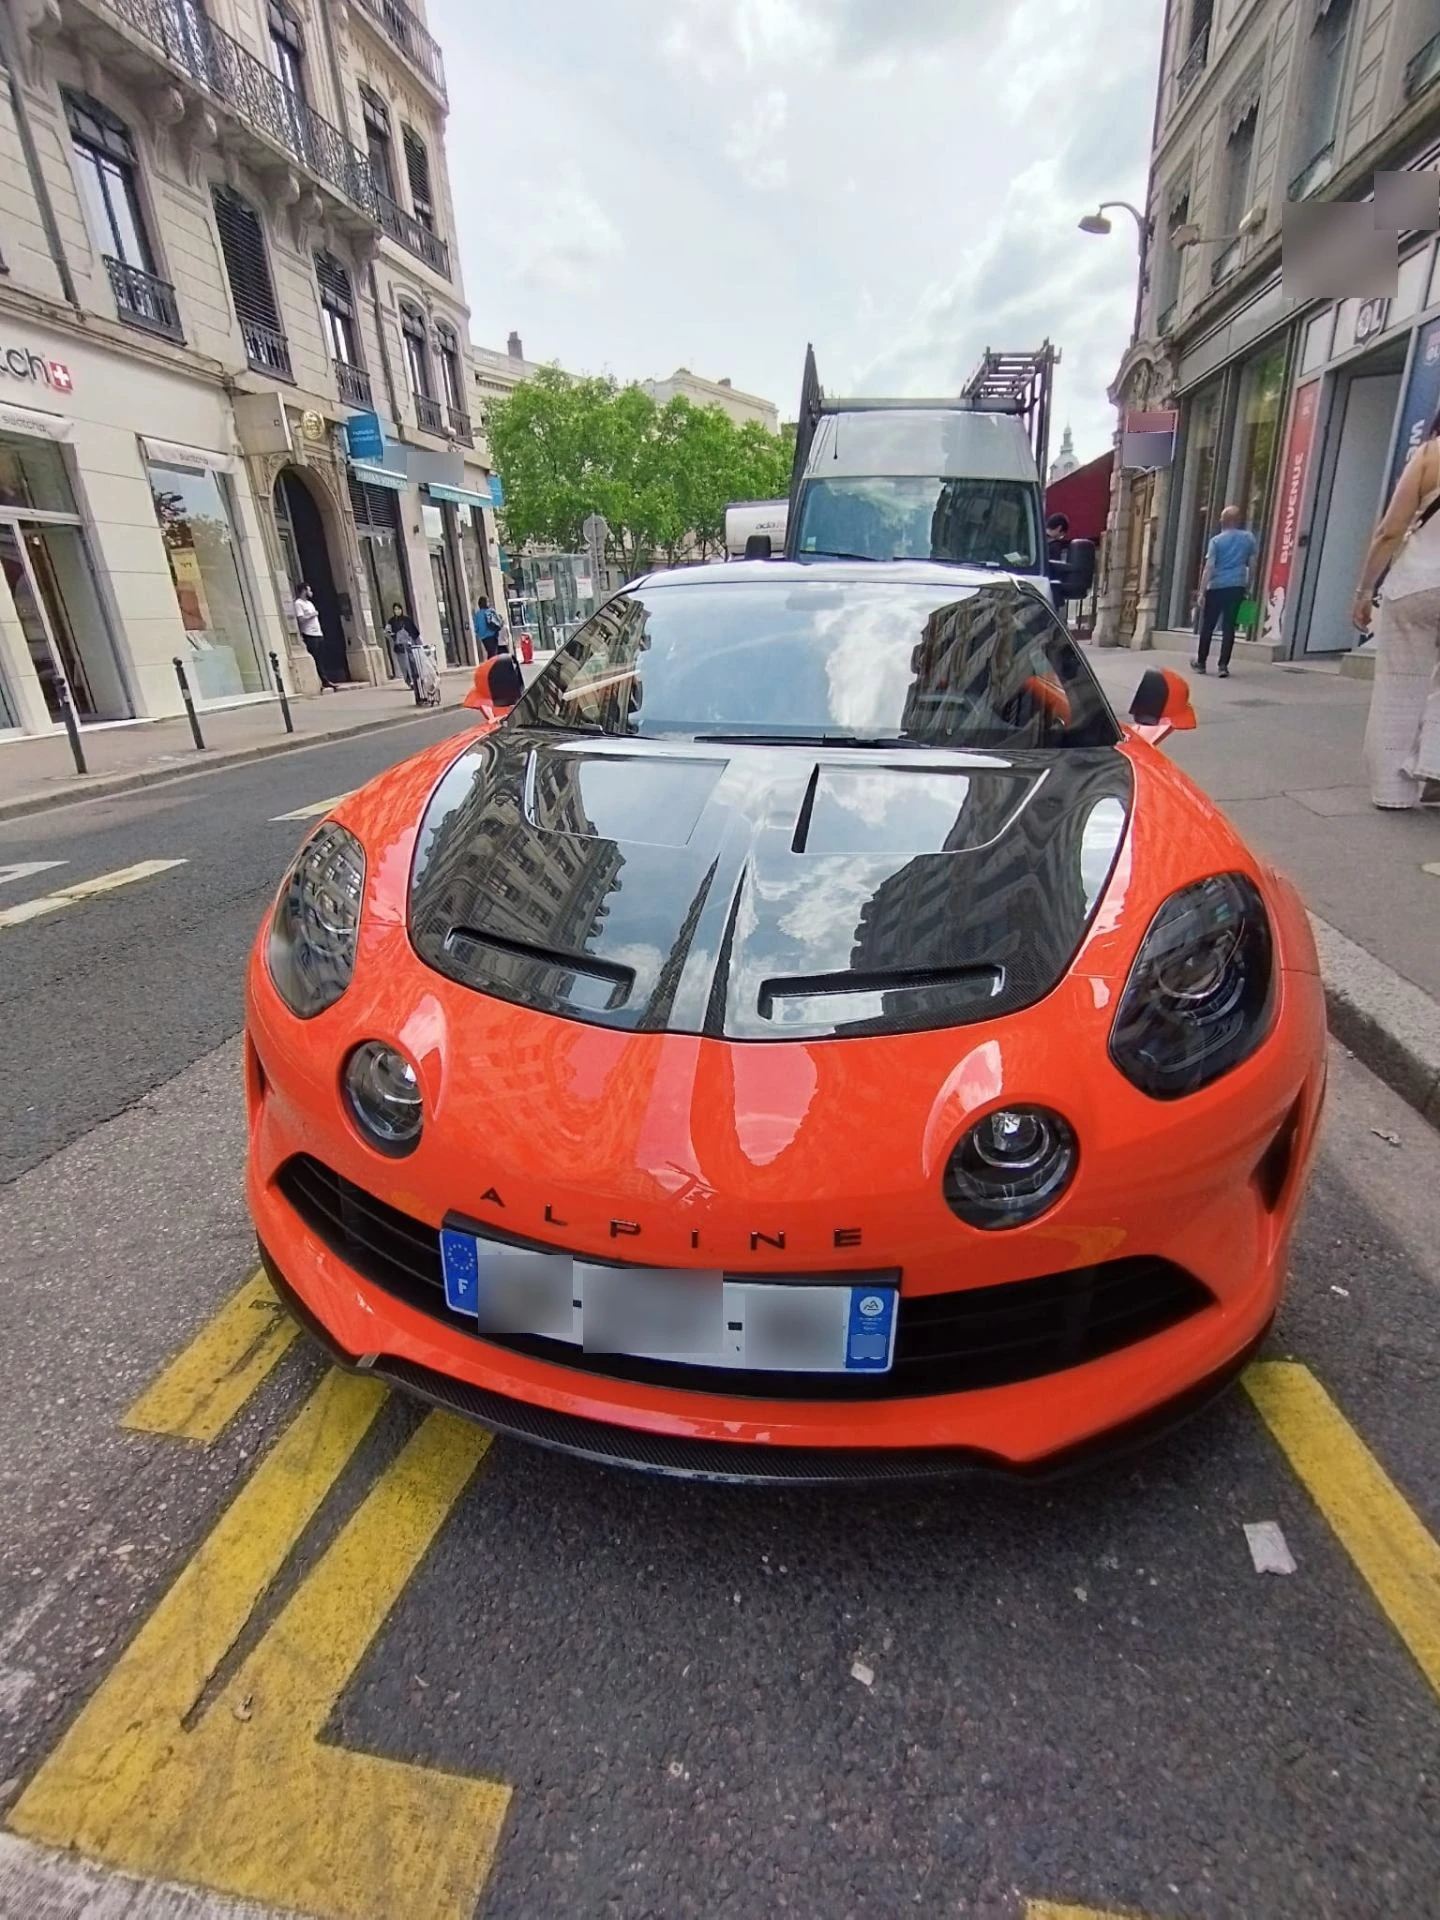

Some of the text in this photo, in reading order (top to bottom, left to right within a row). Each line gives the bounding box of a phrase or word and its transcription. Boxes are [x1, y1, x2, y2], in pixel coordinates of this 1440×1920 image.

[1280, 452, 1304, 564] BIENVENUE
[480, 1187, 862, 1250] ALPINE
[458, 1279, 468, 1295] F
